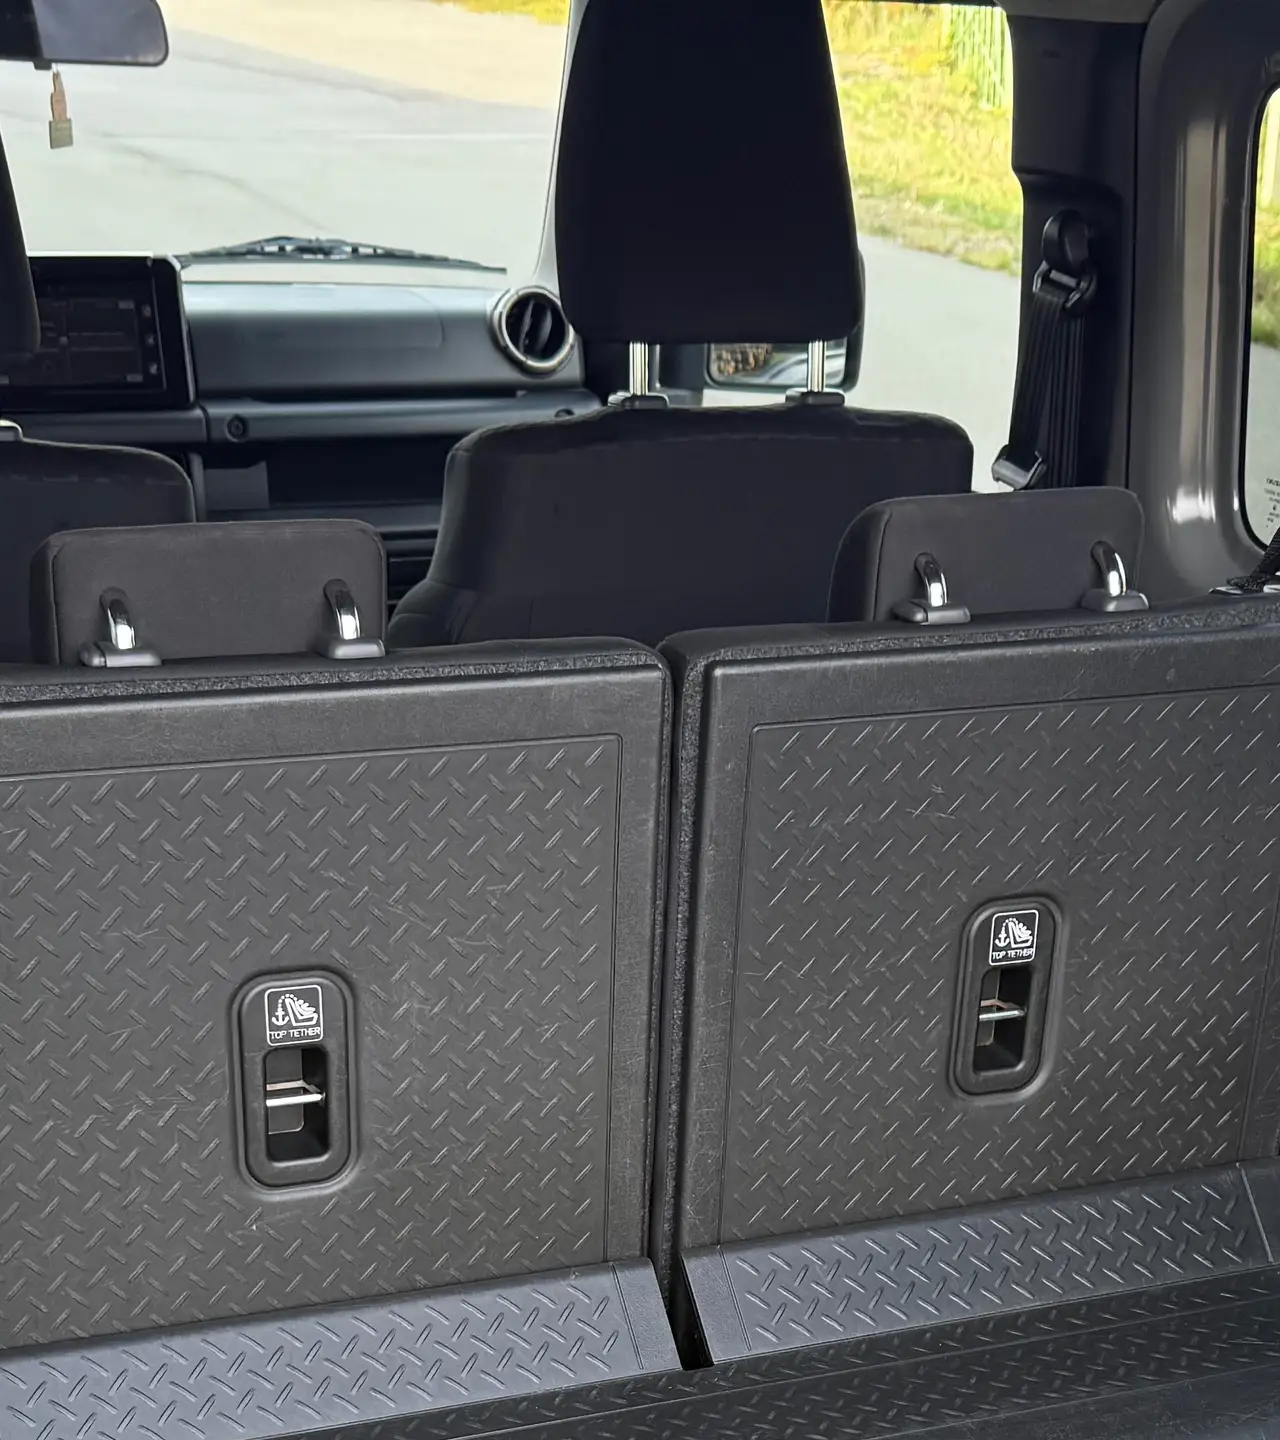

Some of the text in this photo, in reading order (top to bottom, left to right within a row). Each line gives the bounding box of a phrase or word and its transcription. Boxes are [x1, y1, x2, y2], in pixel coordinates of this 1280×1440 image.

[991, 948, 1034, 960] TOP TETHER
[269, 1026, 321, 1040] TOP TETHER
